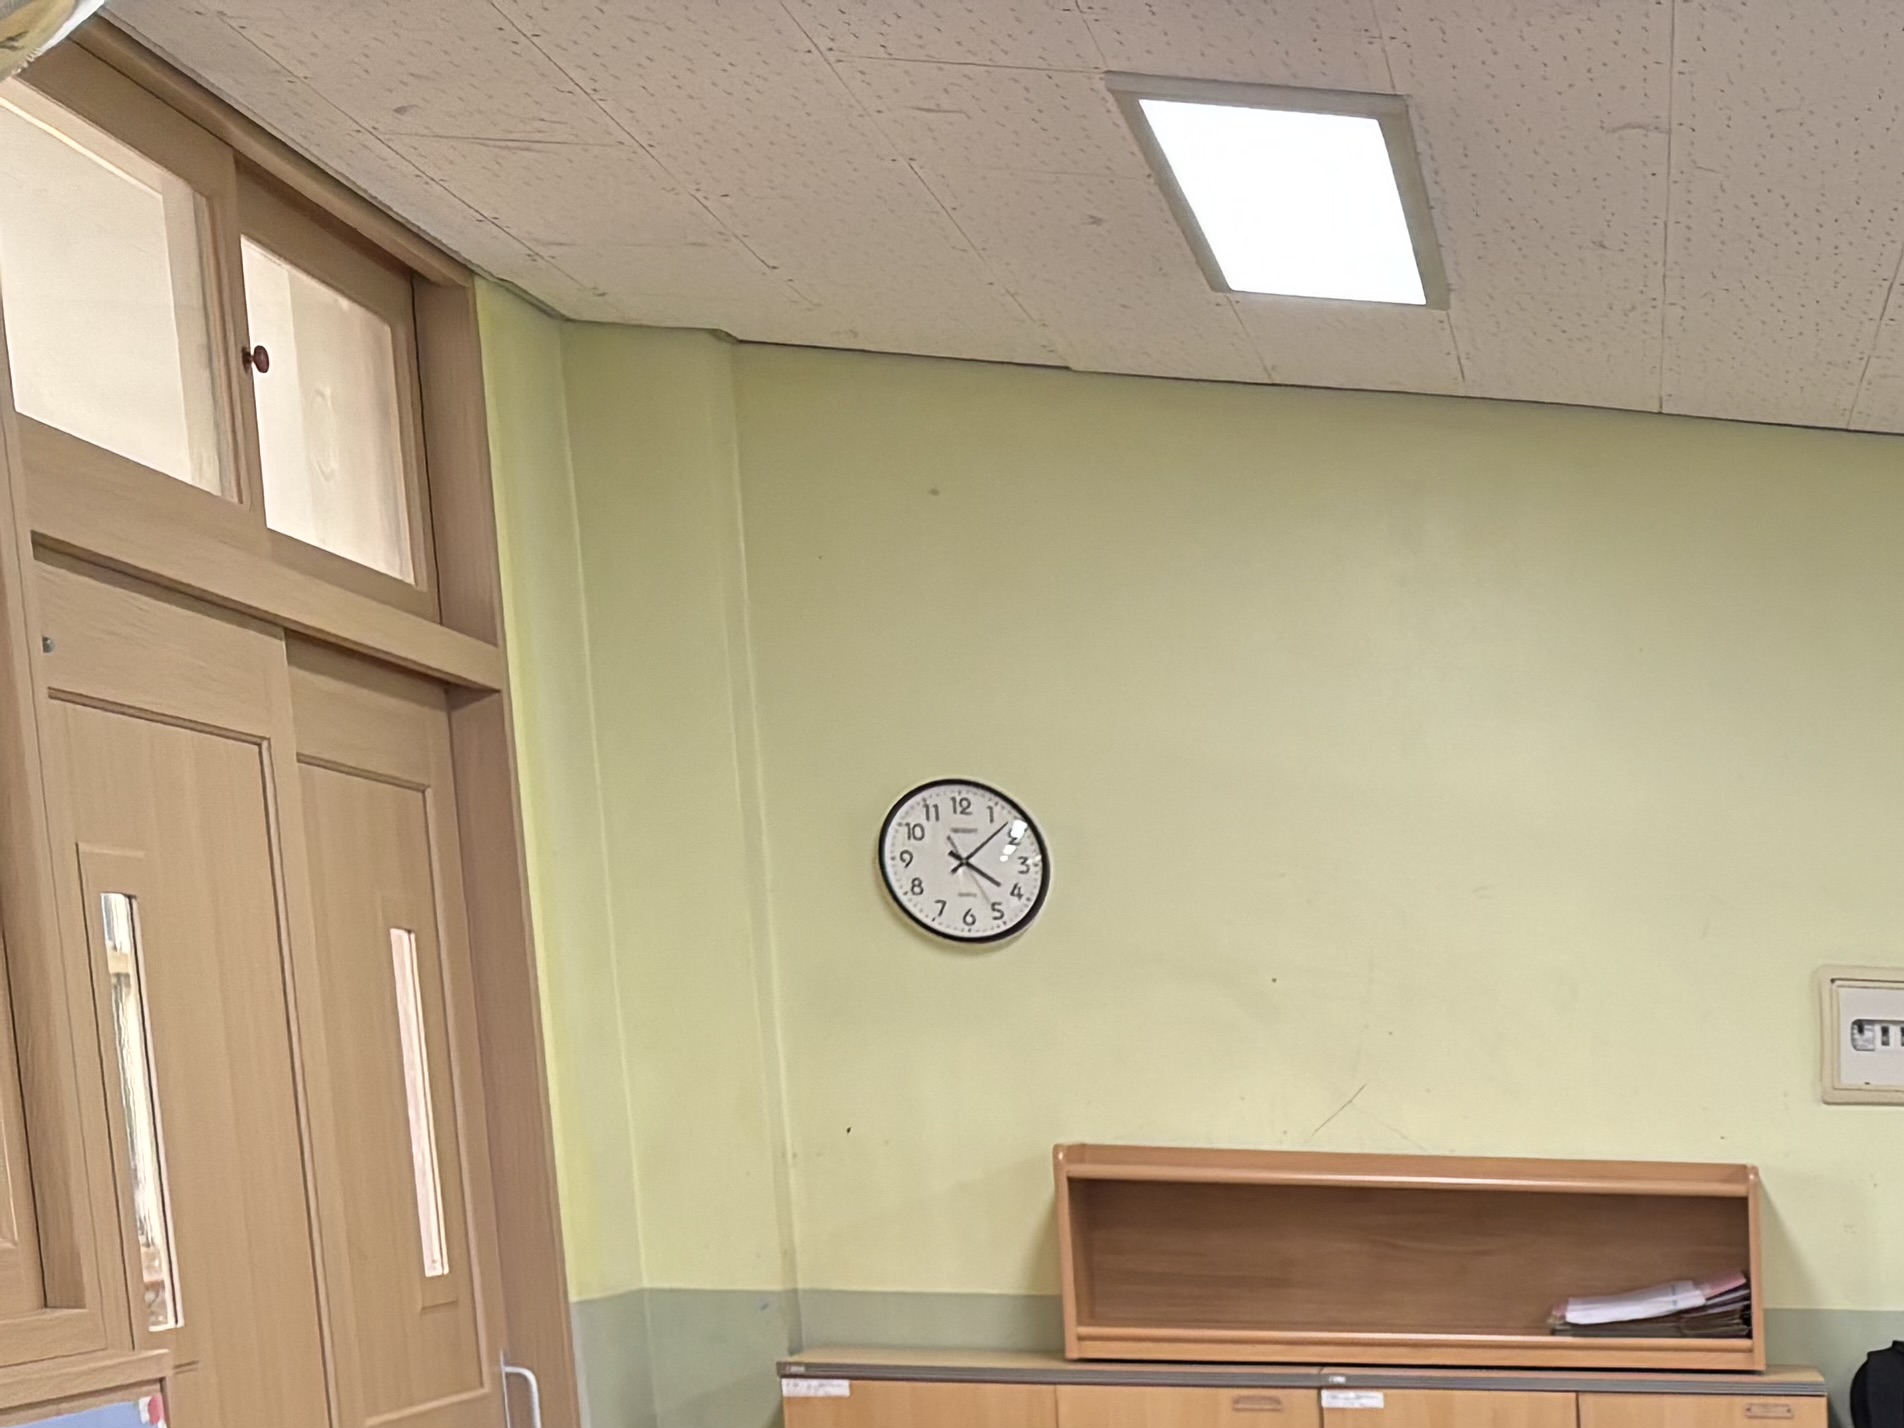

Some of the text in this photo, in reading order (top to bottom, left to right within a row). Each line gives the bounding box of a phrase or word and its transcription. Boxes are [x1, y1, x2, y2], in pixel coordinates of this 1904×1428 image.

[923, 803, 940, 822] 11
[951, 797, 973, 815] 12
[987, 806, 995, 823] 1
[905, 823, 925, 841] 10
[900, 850, 914, 868] 9
[1018, 856, 1030, 875] 3
[911, 877, 924, 896] 8
[1010, 882, 1024, 900] 4
[934, 900, 947, 916] 7
[962, 908, 976, 926] 6
[991, 902, 1005, 920] 5
